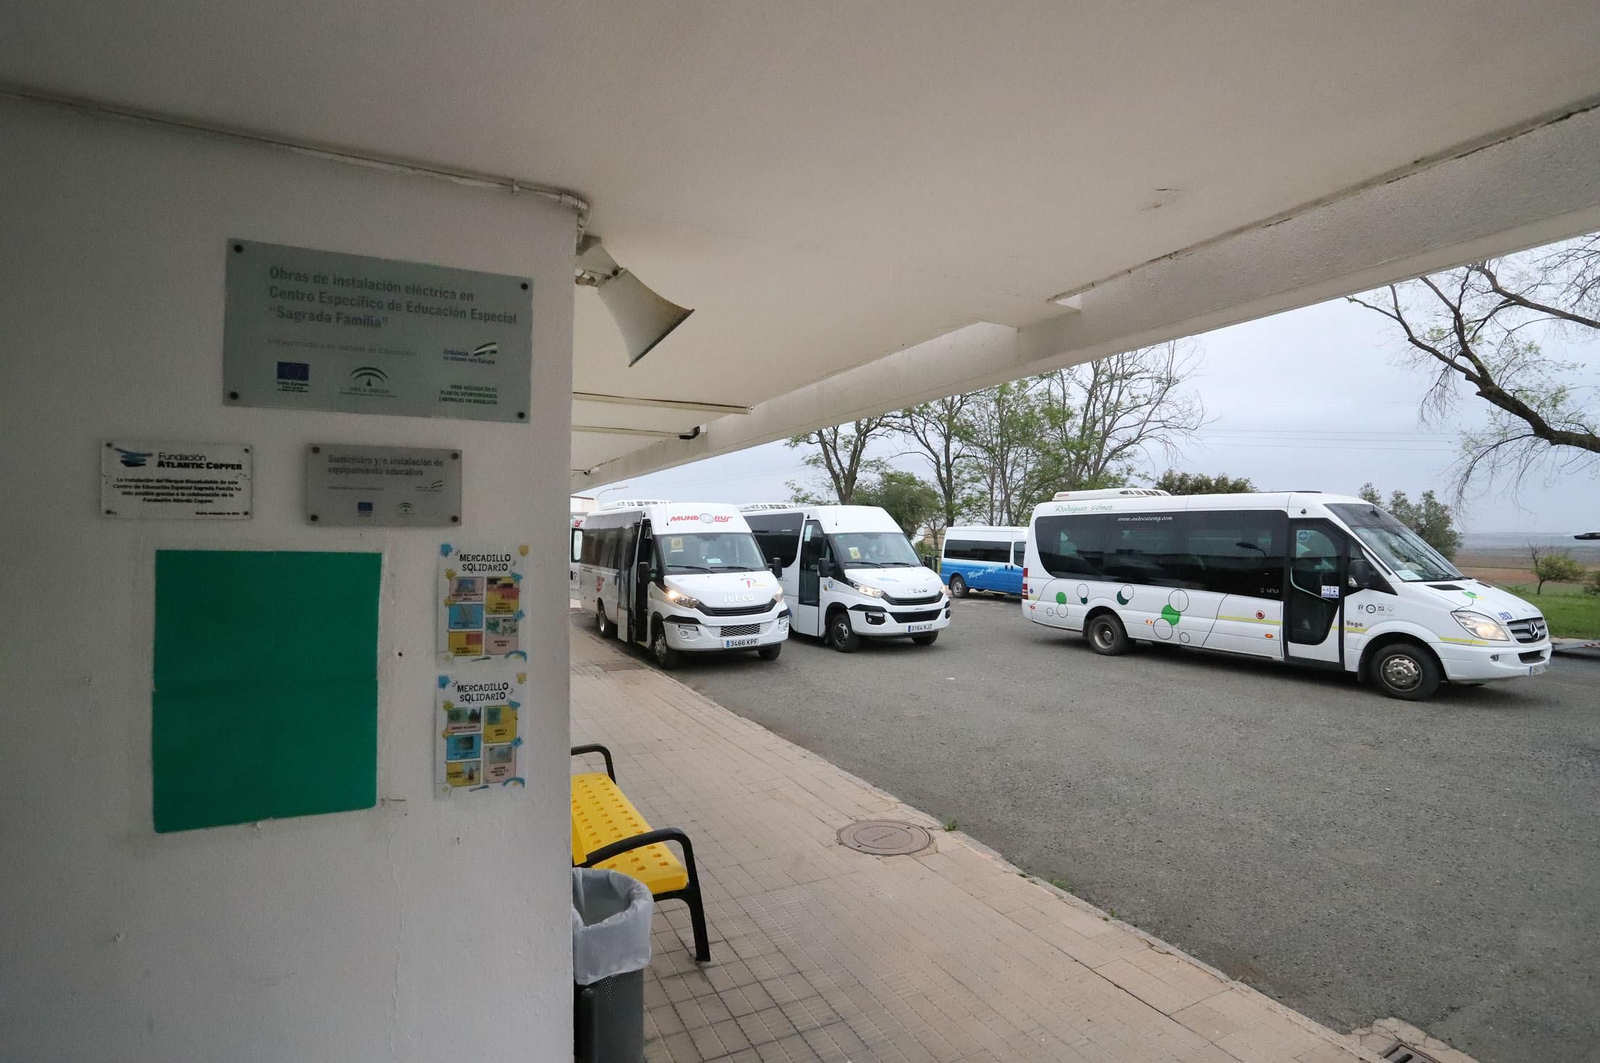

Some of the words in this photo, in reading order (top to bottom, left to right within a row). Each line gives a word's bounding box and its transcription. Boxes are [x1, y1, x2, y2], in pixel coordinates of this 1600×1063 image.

[270, 266, 309, 284] Obras
[314, 272, 328, 284] de
[333, 274, 401, 294] instalación
[405, 282, 456, 300] eléctrica
[460, 292, 474, 302] en
[269, 286, 314, 302] Centro
[319, 290, 384, 311] Específico
[388, 298, 402, 311] de
[406, 301, 466, 318] Educación
[471, 308, 517, 325] Especial
[158, 452, 206, 462] Fundación
[328, 454, 372, 465] Suministro
[374, 456, 387, 467] y/o
[390, 457, 432, 466] instalación
[157, 460, 205, 469] ATLANTIC
[206, 462, 242, 470] COPPER
[328, 465, 383, 475] equipamiento
[386, 466, 423, 476] educativo
[459, 554, 511, 562] MERCADILLO
[462, 563, 508, 572] SOLIDARIO
[723, 594, 754, 603] IVECO
[457, 682, 508, 693] MERCADILLO
[460, 692, 506, 702] SOLIDARIO
